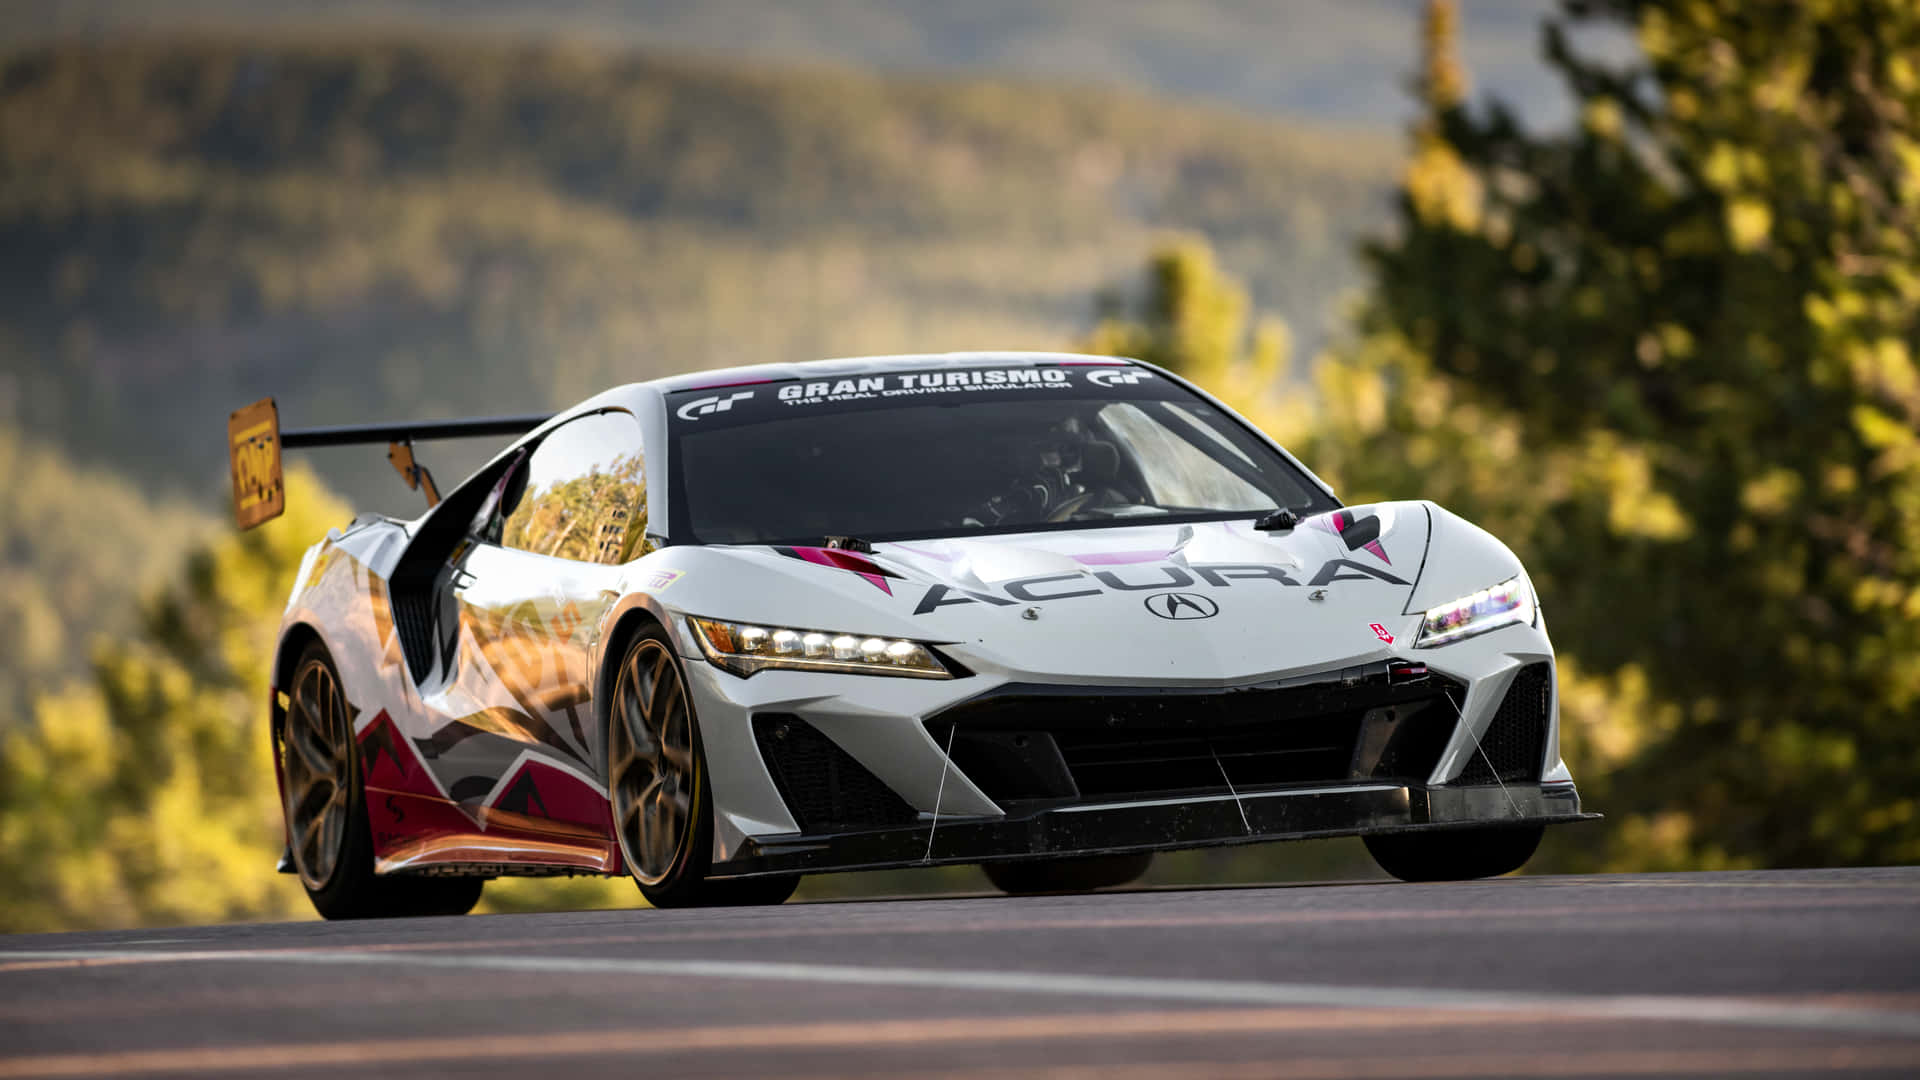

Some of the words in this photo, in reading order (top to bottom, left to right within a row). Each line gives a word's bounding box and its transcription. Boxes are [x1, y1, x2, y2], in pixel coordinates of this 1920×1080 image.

[777, 376, 885, 400] GRAN
[898, 369, 1066, 388] TURISMO
[783, 396, 823, 406] THE
[827, 391, 878, 401] REAL
[882, 386, 961, 396] DRIVING
[963, 381, 1072, 391] SIMULATOR
[913, 558, 1411, 616] ACURA
[1372, 623, 1391, 640] TOW
